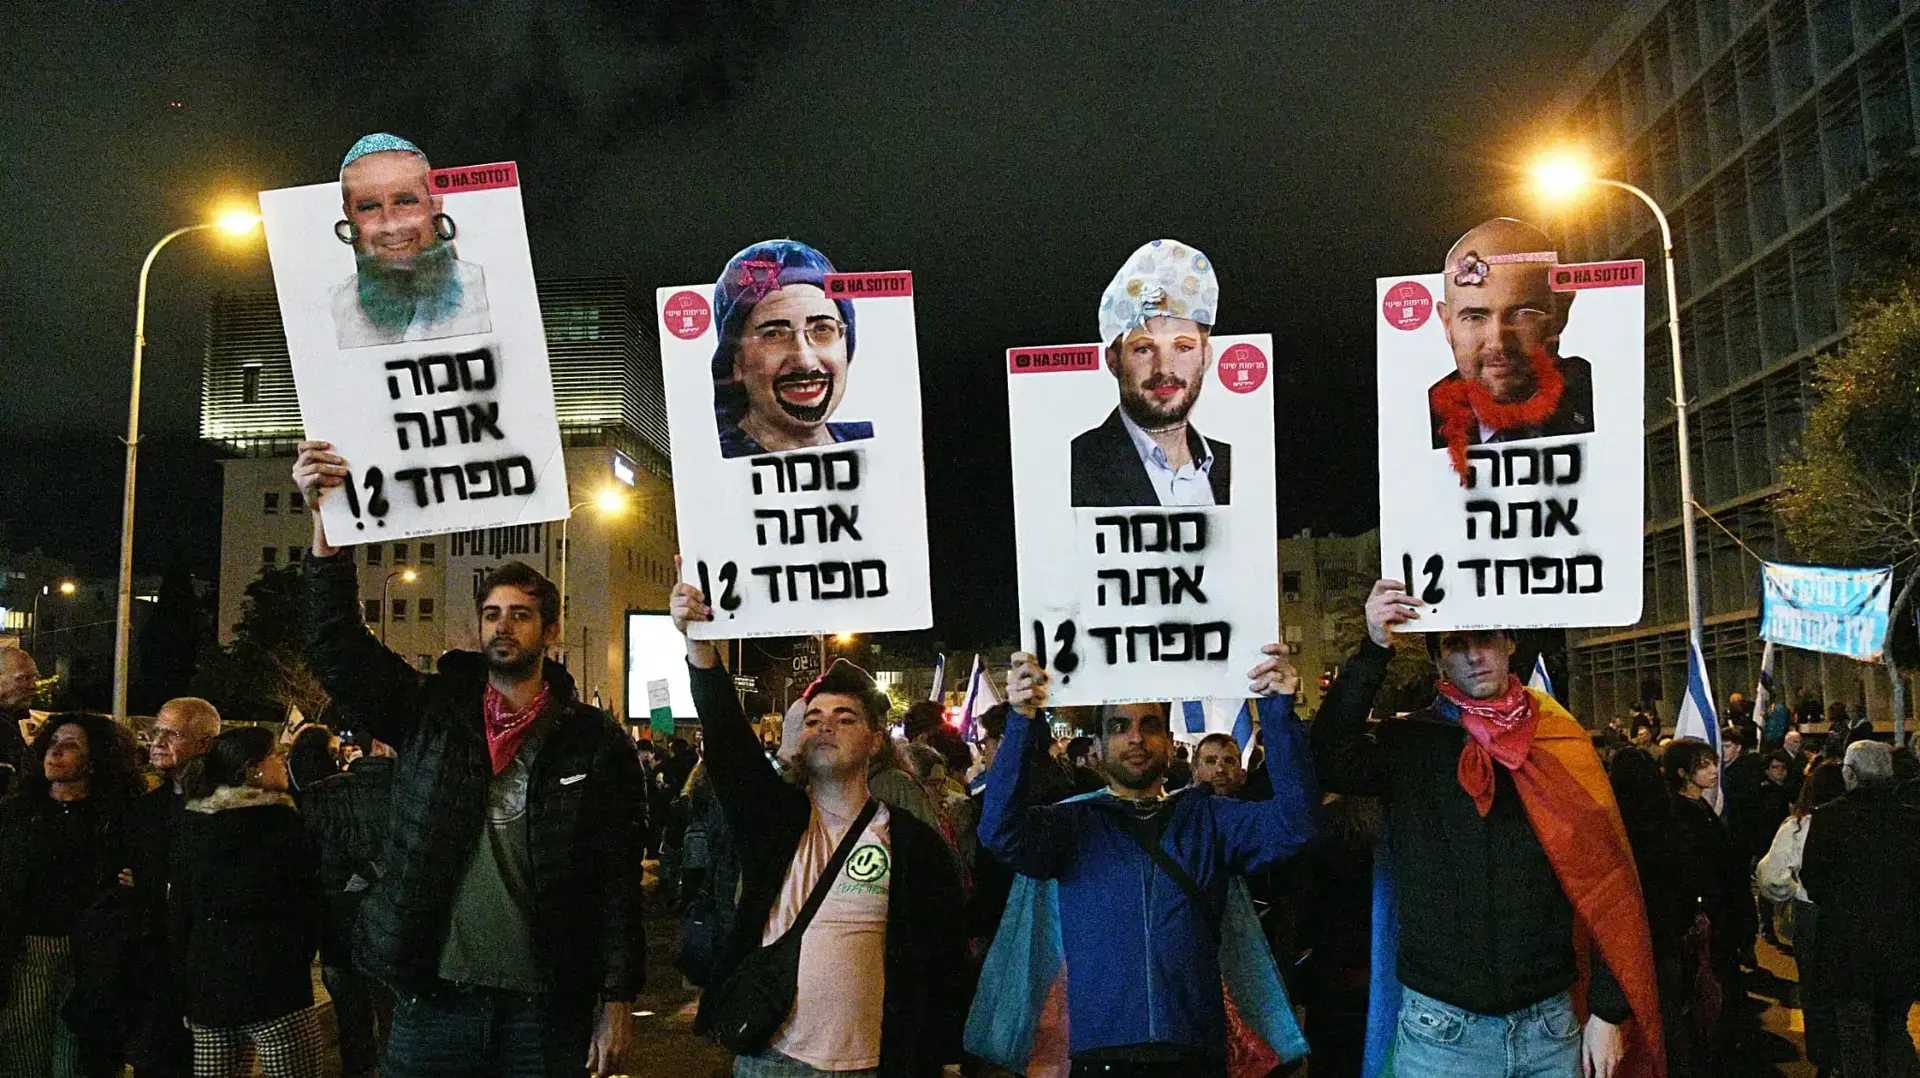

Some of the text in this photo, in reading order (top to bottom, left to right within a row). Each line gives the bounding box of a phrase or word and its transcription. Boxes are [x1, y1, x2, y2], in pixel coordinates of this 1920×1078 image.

[451, 168, 510, 187] HA.SOTOT
[847, 276, 907, 293] HA.SOTOT
[1574, 266, 1639, 284] HA.SOTOT
[384, 347, 497, 399] ממה
[1032, 352, 1094, 368] HA.SOTOT
[394, 402, 505, 450] אתה
[751, 450, 860, 495] ממה
[1466, 443, 1582, 489] ממה
[753, 504, 863, 546] אתה
[1095, 512, 1208, 554] ממה
[1466, 499, 1581, 540] אתה
[1096, 564, 1209, 606] אתה
